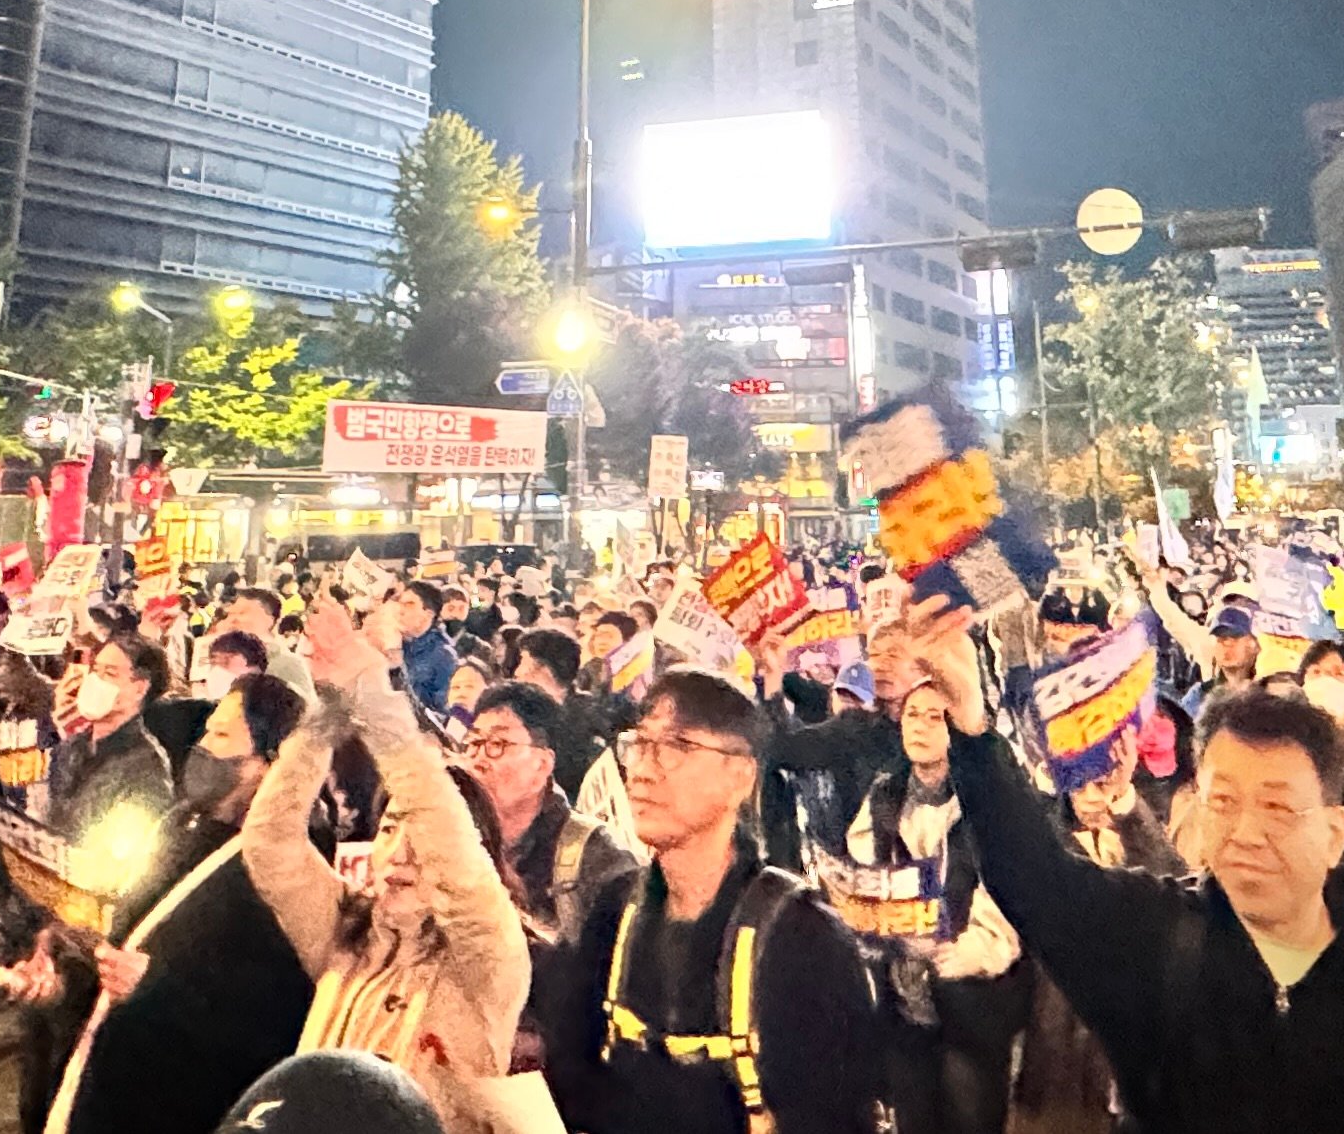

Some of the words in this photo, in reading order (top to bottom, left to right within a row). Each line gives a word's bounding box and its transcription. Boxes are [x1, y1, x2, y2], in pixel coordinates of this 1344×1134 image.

[346, 407, 472, 441] 범국민항쟁으로
[386, 443, 428, 466] 전쟁광
[431, 444, 482, 466] 윤석열을
[484, 446, 536, 467] 탄핵하자!
